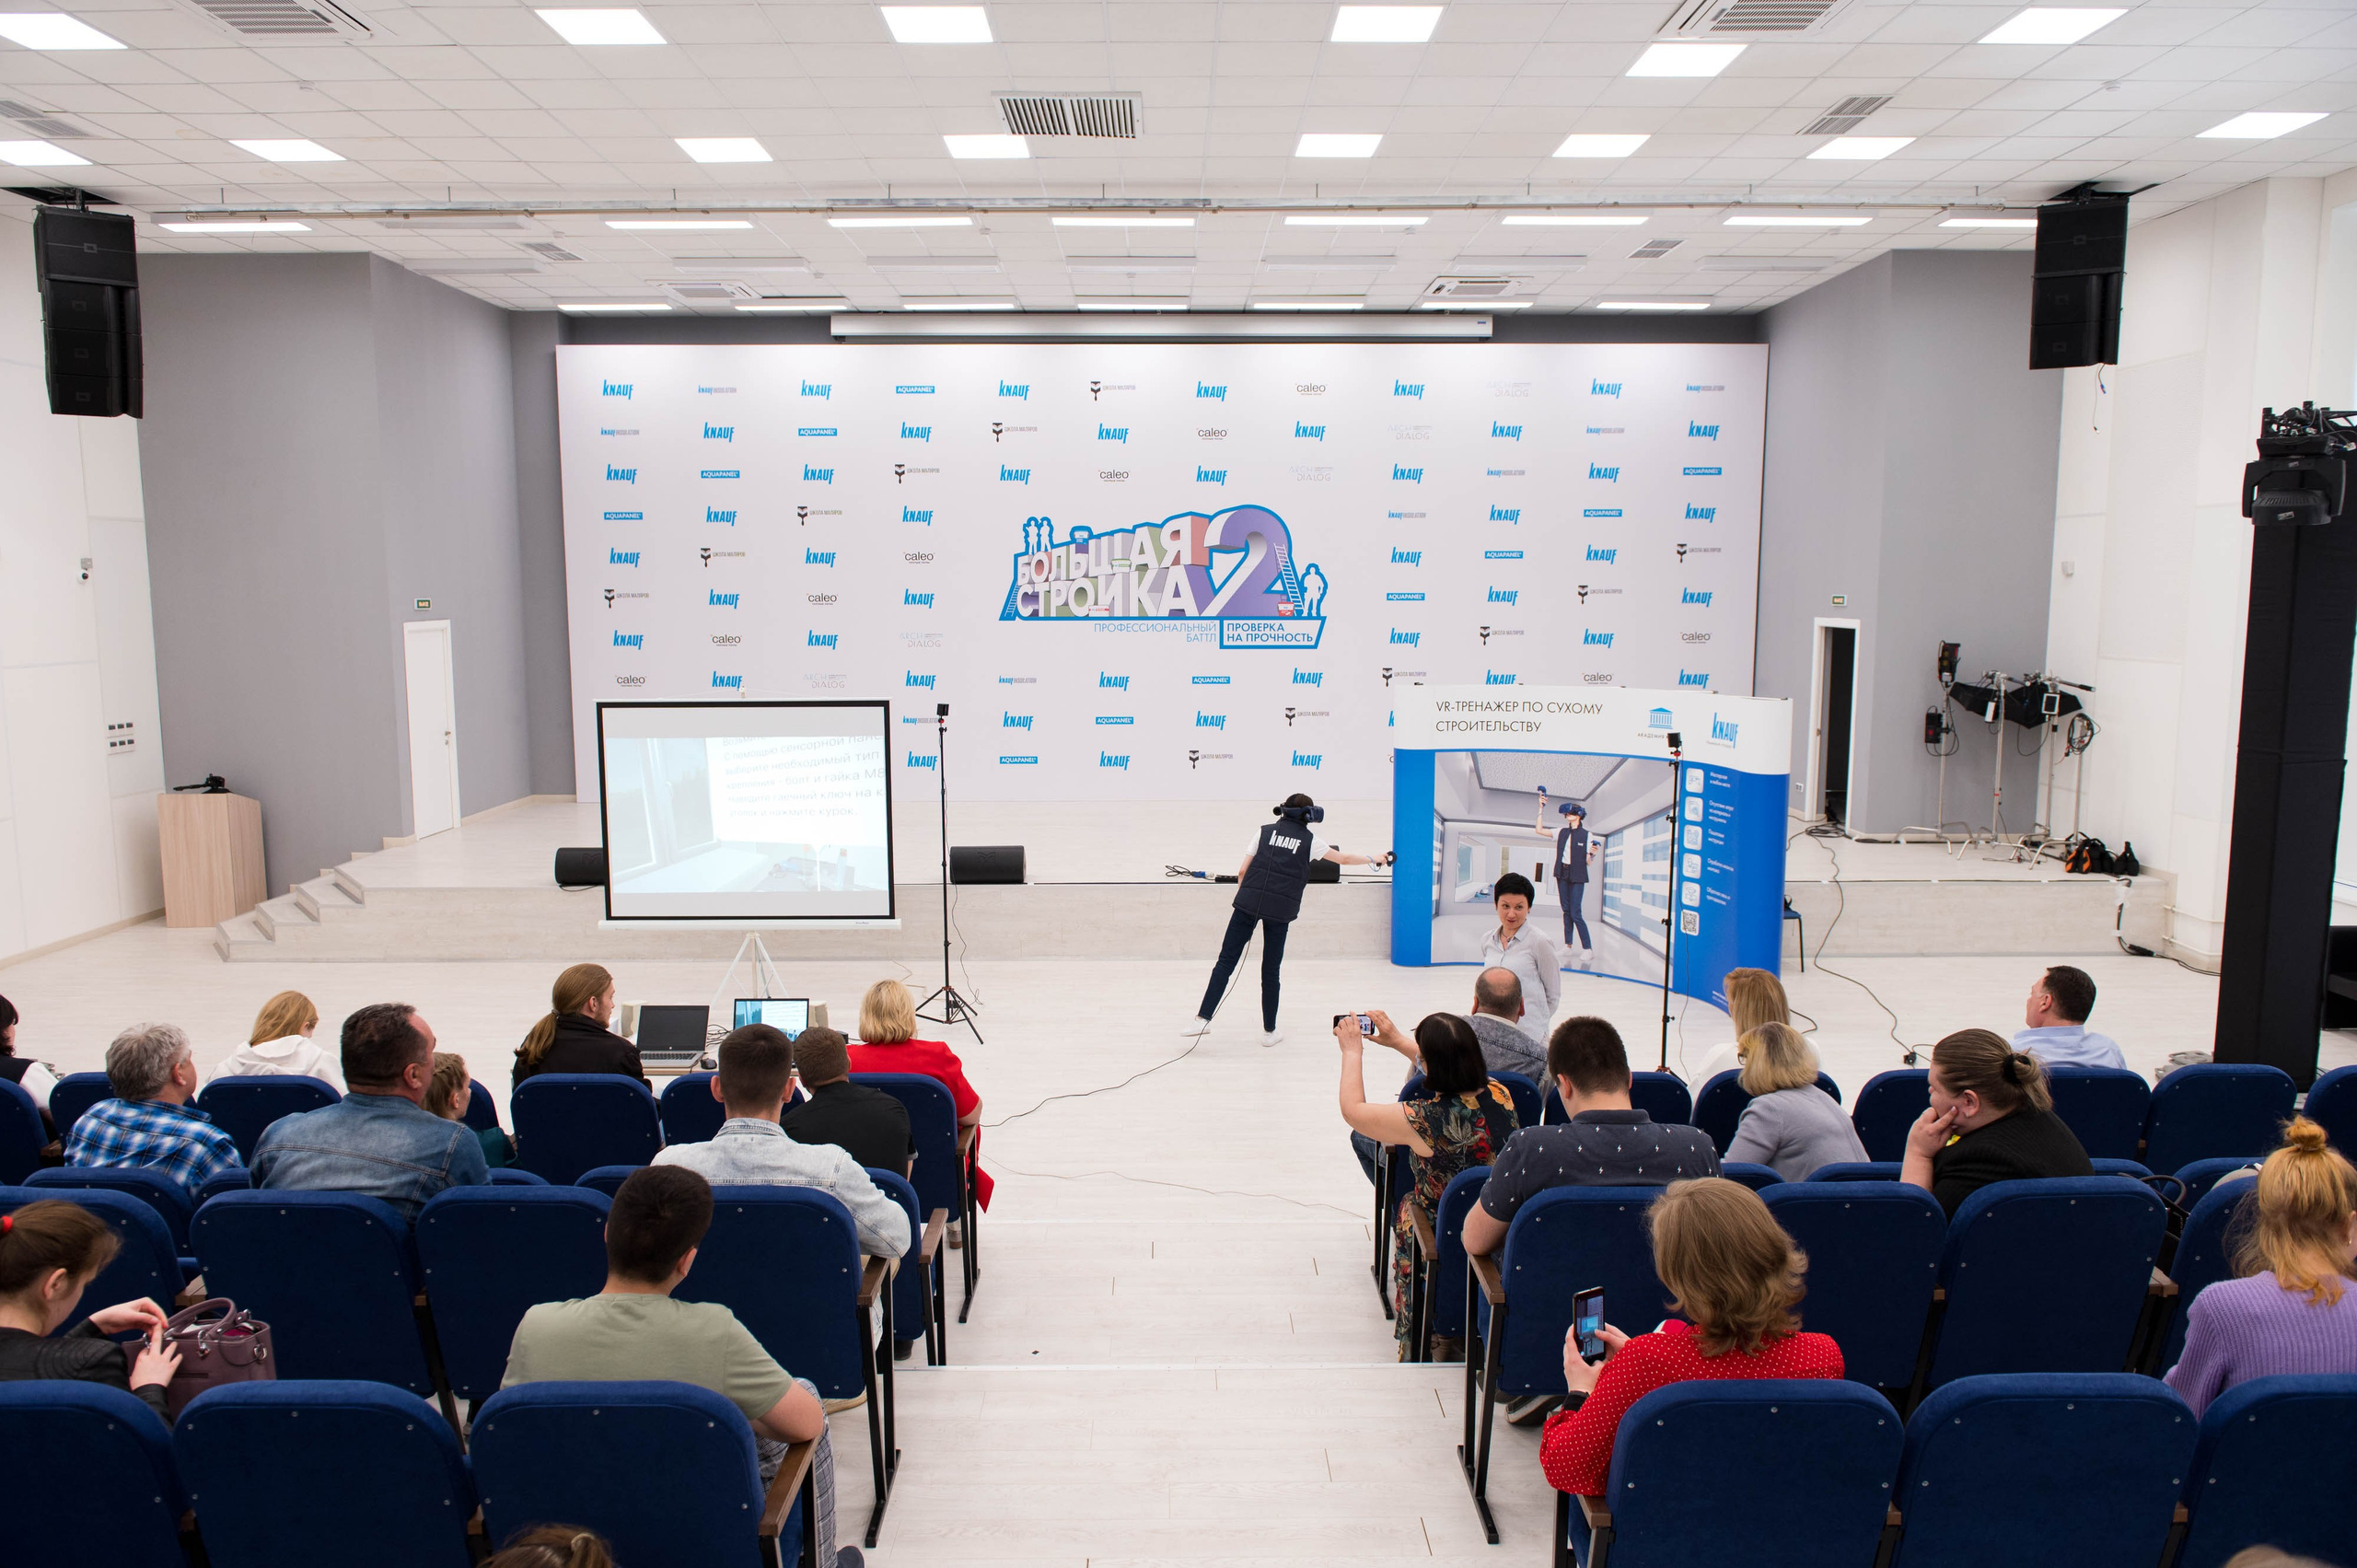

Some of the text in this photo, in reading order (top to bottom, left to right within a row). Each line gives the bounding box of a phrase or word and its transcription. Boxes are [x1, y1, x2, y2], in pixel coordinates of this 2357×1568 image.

[1094, 621, 1216, 633] ПРОФЕССИОНАЛЬНЫЙ
[1226, 622, 1285, 633] ПРОВЕРКА
[1186, 633, 1216, 643] БАТТЛ
[1226, 633, 1314, 643] НА ПРОЧНОСТЬ
[1436, 701, 1603, 714] VR-ТРЕНАЖЕР ПО СУХОМУ
[1436, 720, 1541, 733] СТРОИТЕЛЬСТВУ
